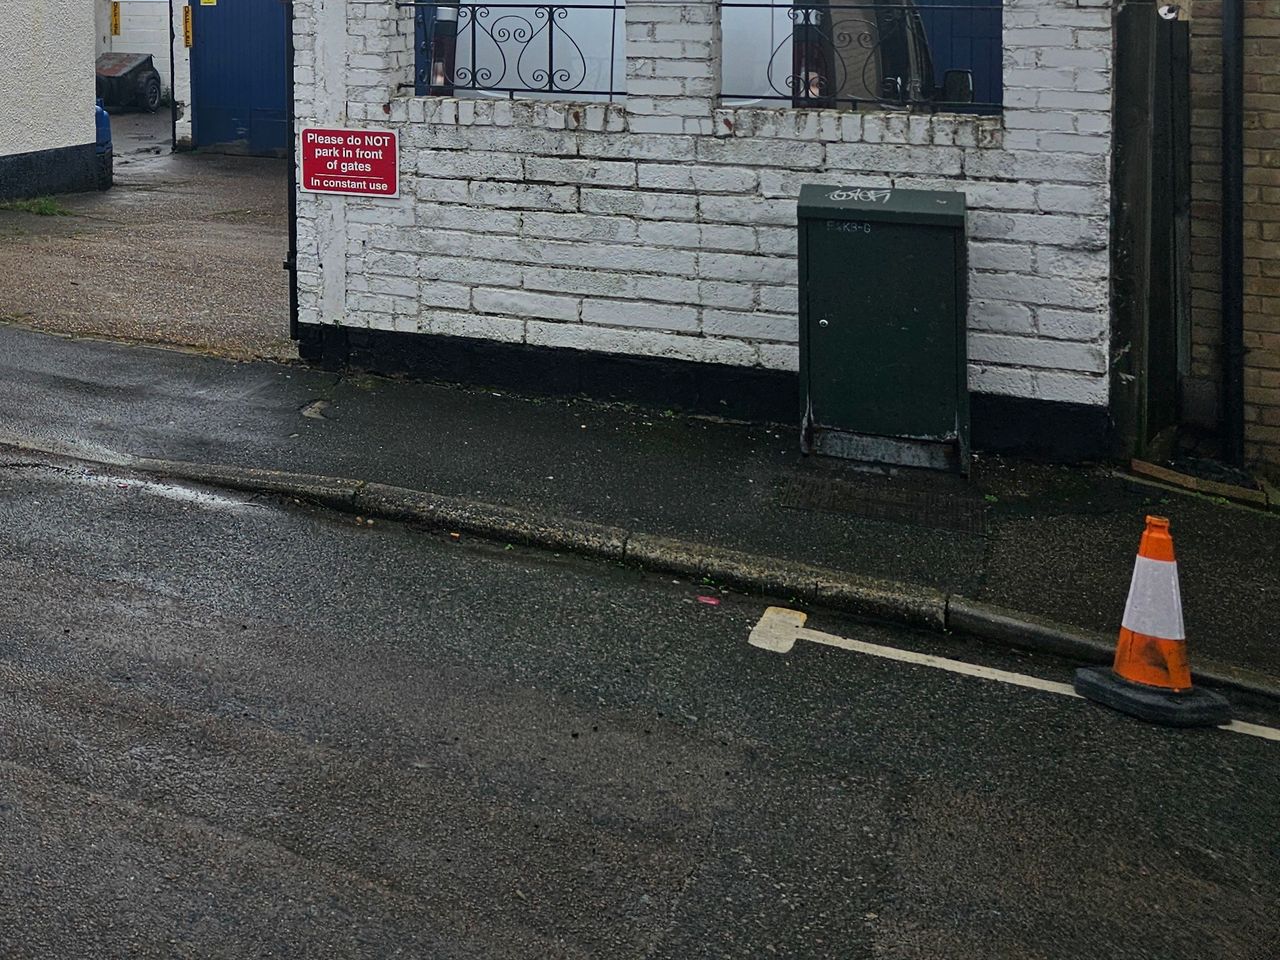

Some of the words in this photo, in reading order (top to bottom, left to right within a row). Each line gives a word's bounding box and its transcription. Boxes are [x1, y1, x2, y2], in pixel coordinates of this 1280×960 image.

[307, 132, 344, 145] Please
[347, 135, 361, 146] do
[365, 135, 390, 147] NOT
[315, 147, 339, 158] park
[342, 147, 353, 158] in
[355, 148, 383, 159] front
[326, 160, 338, 170] of
[340, 161, 372, 172] gates
[311, 177, 320, 186] In
[323, 179, 367, 189] constant
[369, 182, 388, 190] use
